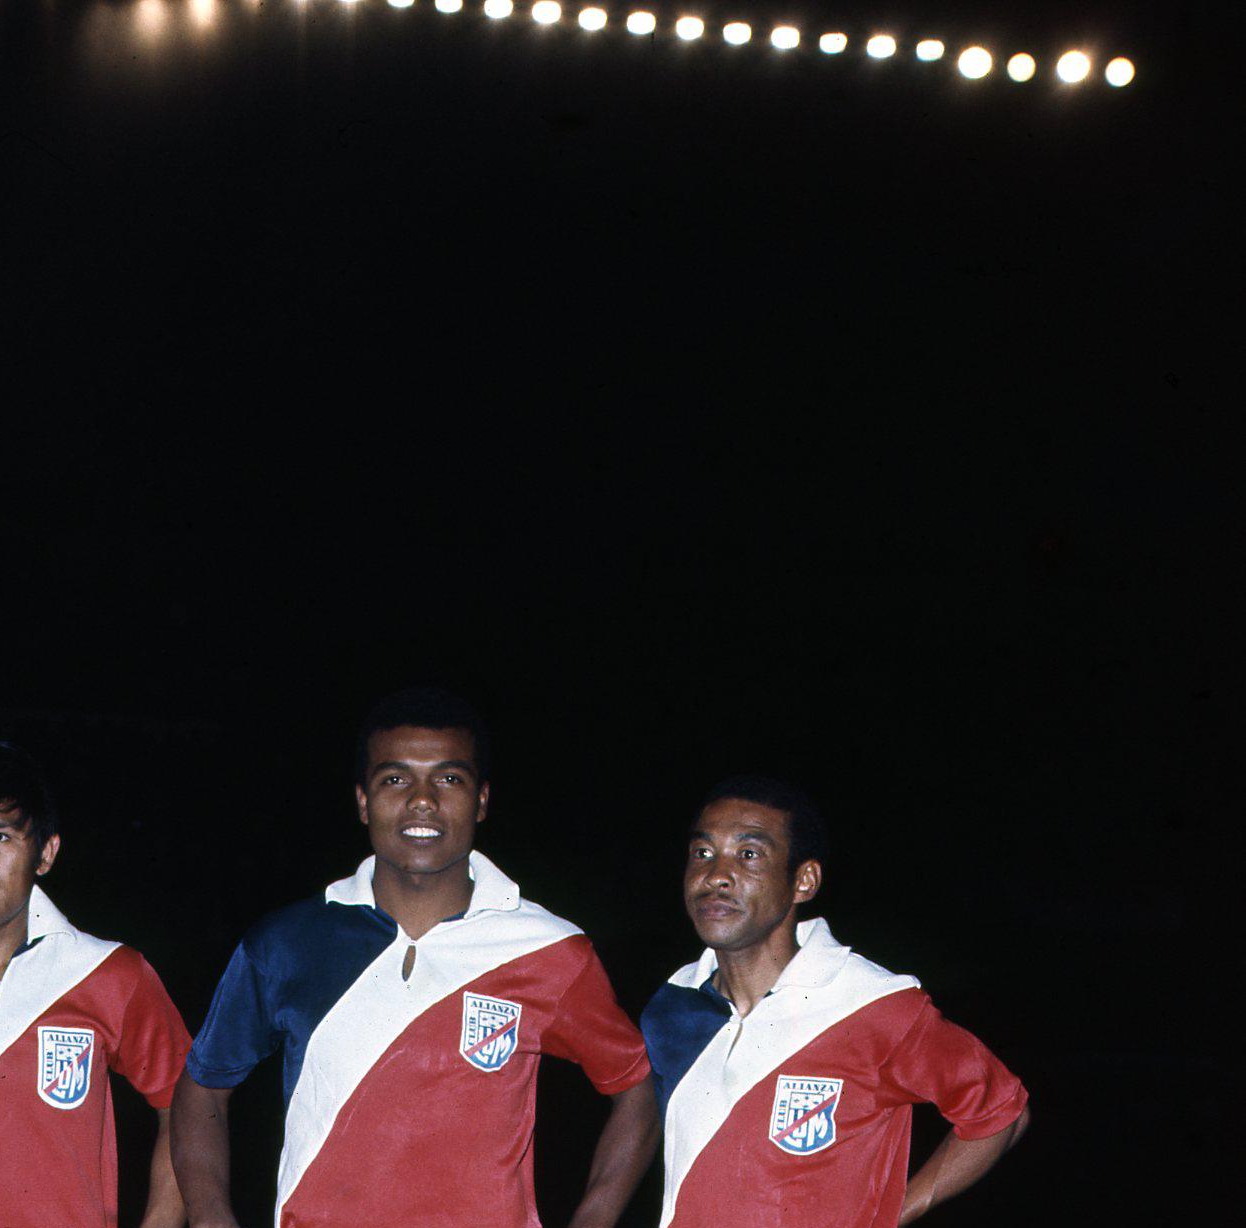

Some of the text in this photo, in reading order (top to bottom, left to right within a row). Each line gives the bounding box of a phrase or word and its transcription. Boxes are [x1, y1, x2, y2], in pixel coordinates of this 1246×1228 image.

[470, 1000, 516, 1017] ALIANZA
[47, 1033, 90, 1045] ALIANZA
[467, 1016, 476, 1046] CLUB
[45, 1051, 54, 1082] CLUB
[783, 1082, 835, 1093] ALIANZA
[776, 1099, 788, 1131] CLUB
